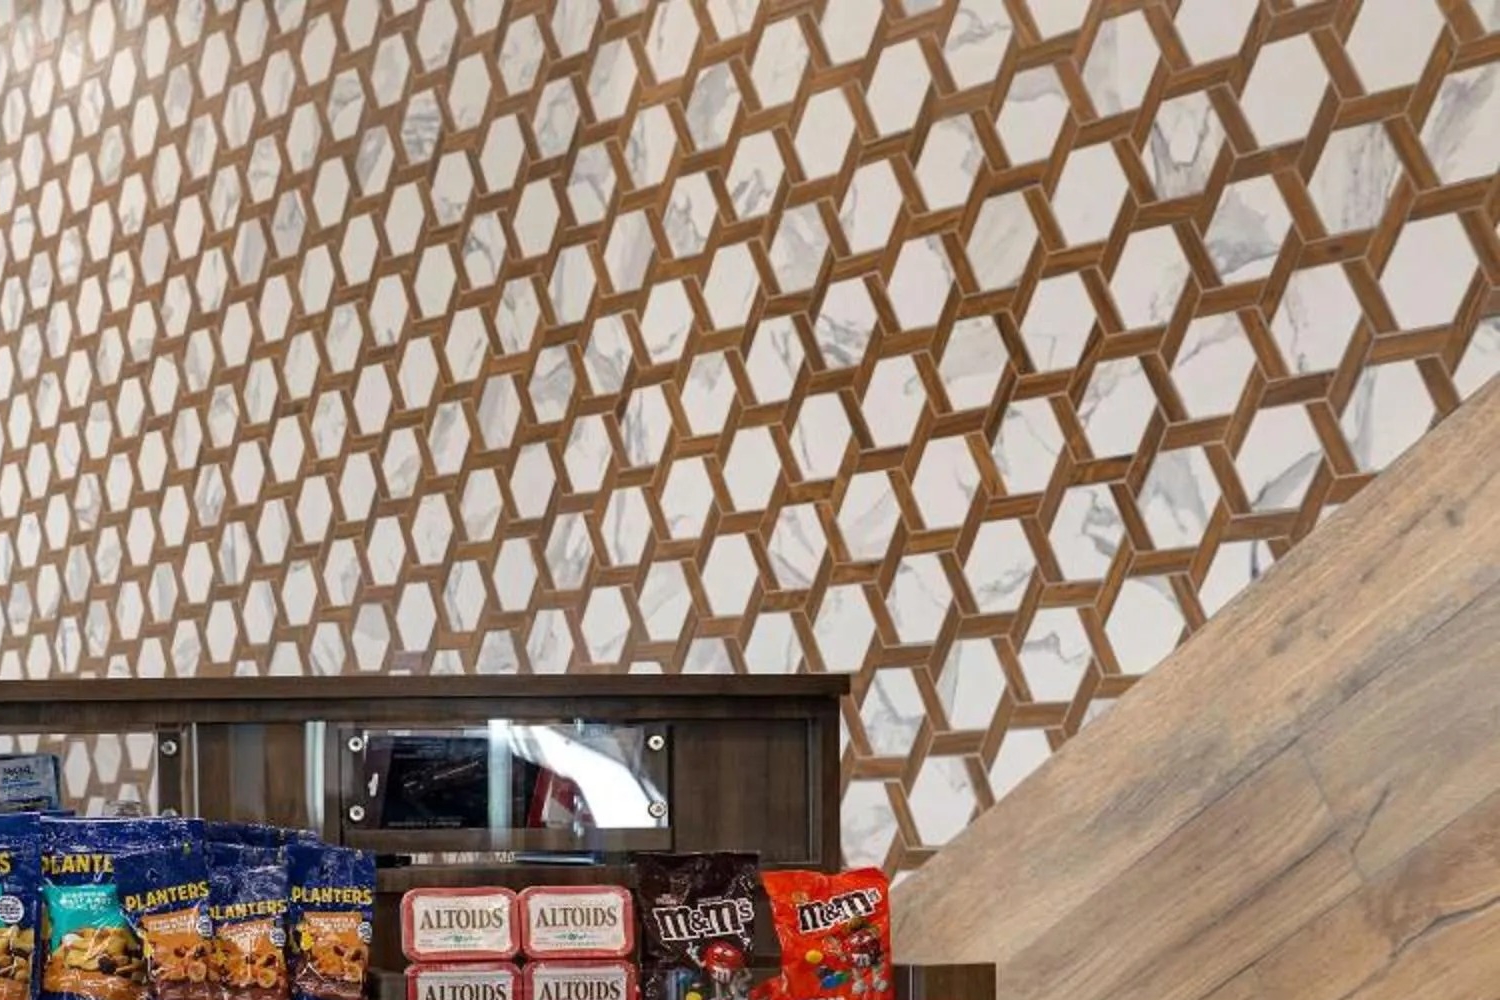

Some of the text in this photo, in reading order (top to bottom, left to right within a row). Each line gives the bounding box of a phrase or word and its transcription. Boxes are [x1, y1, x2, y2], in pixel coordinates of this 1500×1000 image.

[125, 881, 210, 912] PLANTERS
[291, 885, 374, 906] PLANTERS
[419, 908, 504, 931] ALTOIDS
[535, 907, 618, 928] ALTOIDS
